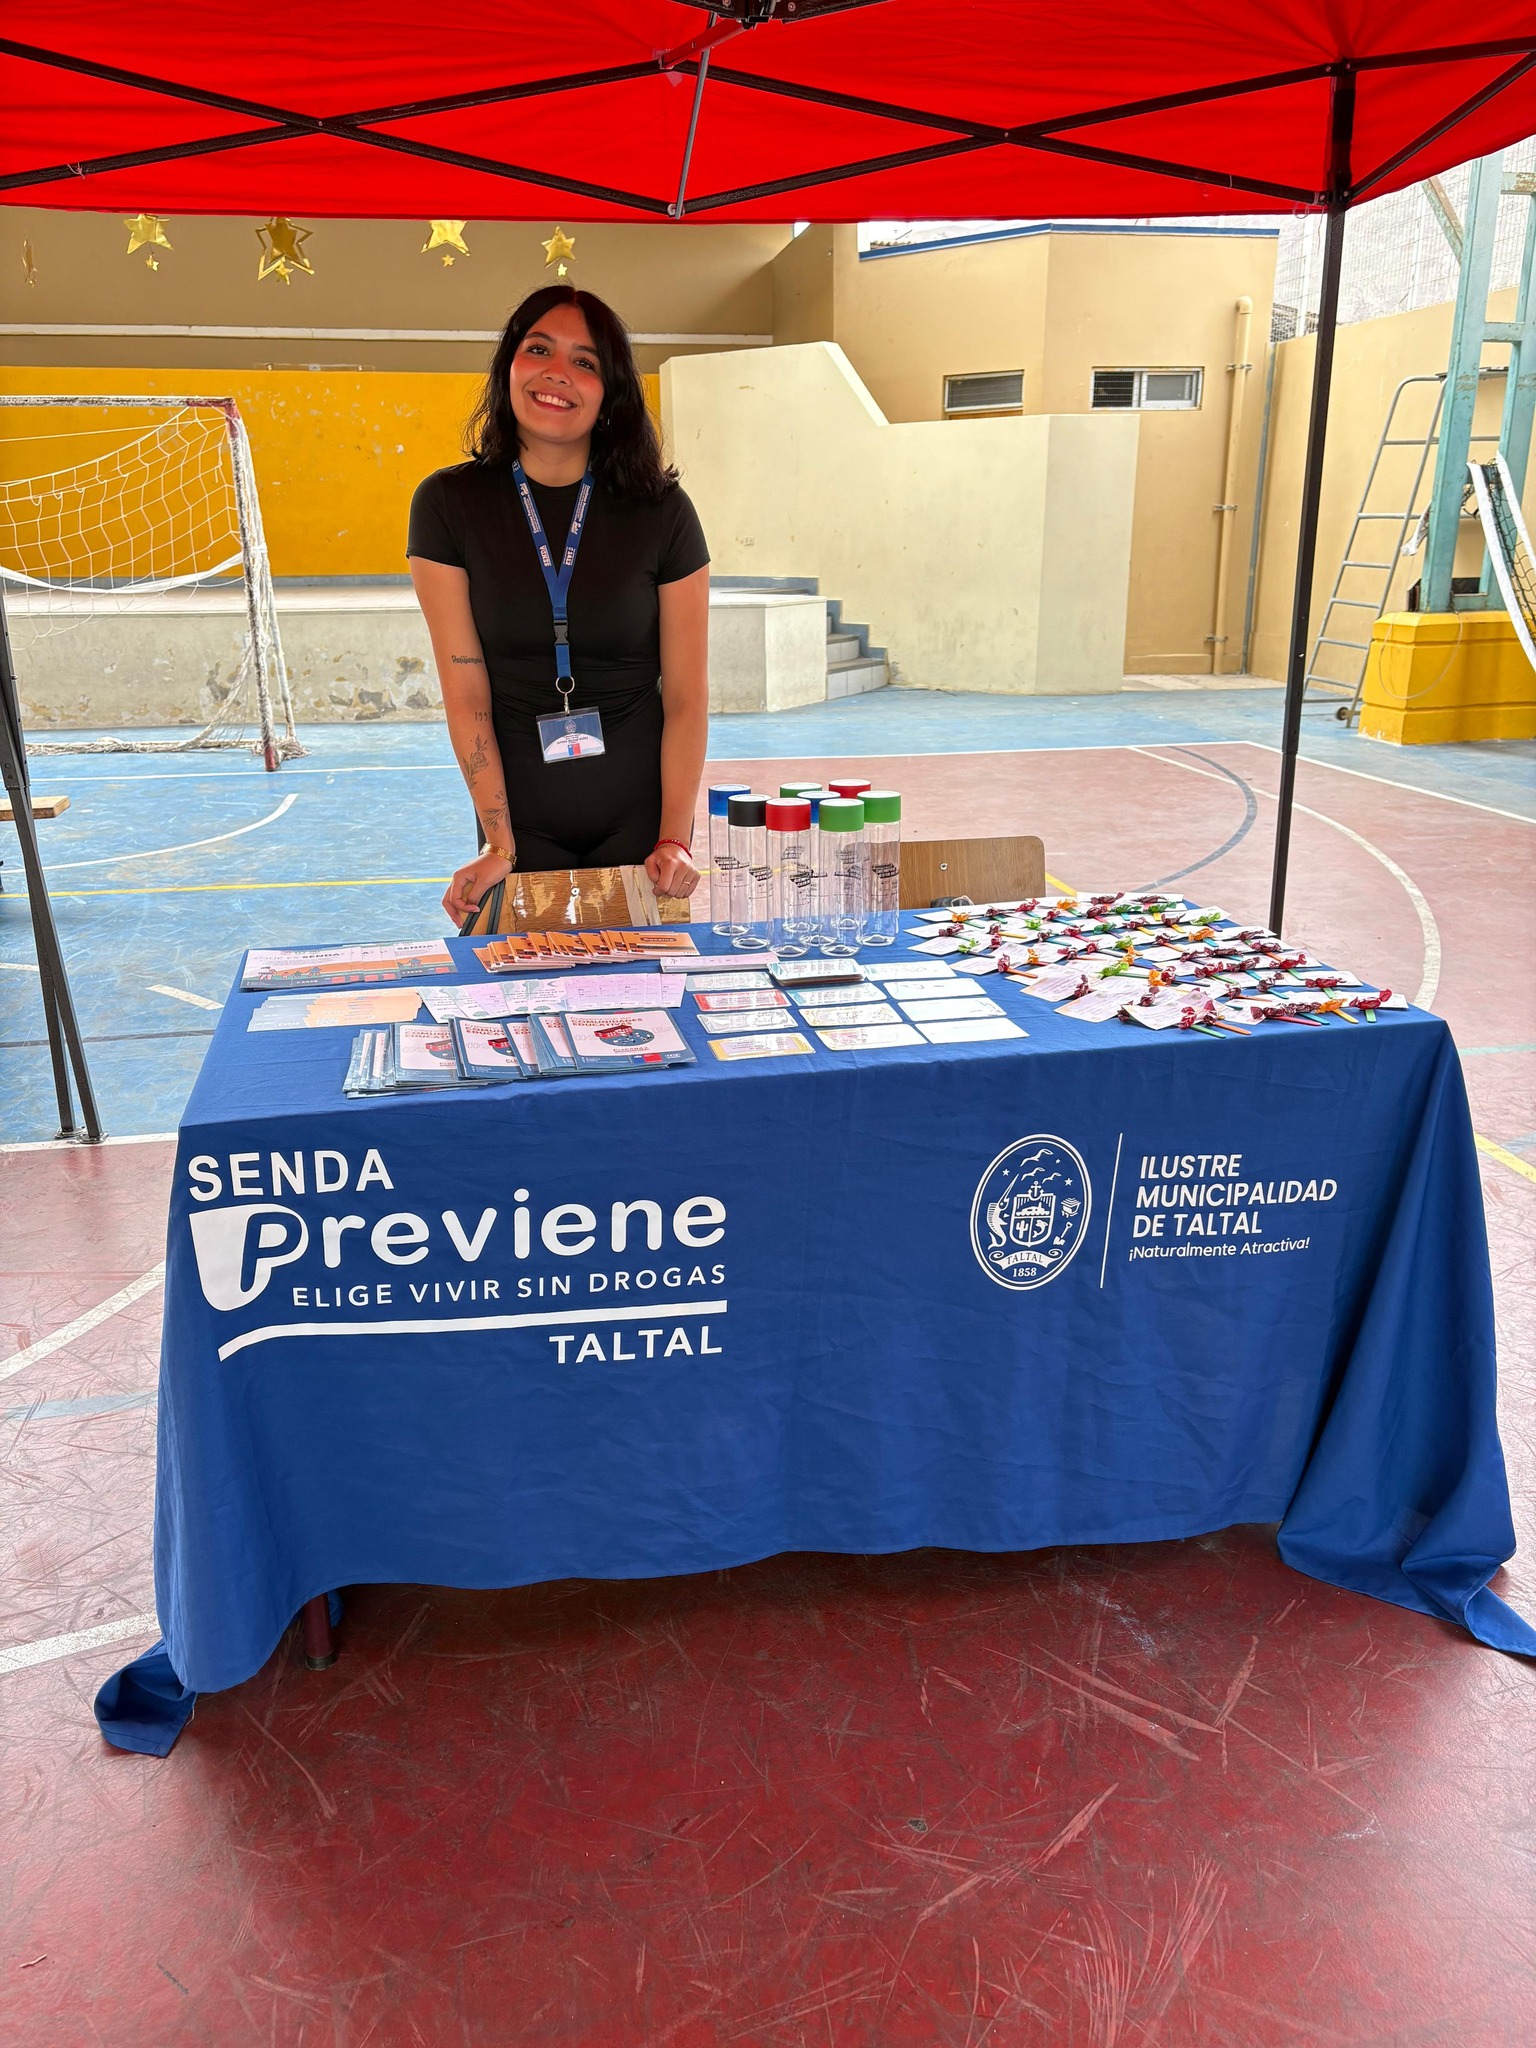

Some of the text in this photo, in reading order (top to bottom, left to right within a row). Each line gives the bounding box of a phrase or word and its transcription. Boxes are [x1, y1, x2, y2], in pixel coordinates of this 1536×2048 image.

[188, 1150, 395, 1202] SENDA
[1140, 1154, 1243, 1179] ILUSTRE
[1136, 1178, 1339, 1209] MUNICIPALIDAD
[1132, 1211, 1263, 1238] DE TALTAL
[238, 1187, 728, 1293] Previene
[1128, 1236, 1310, 1262] ¡Naturalmente Atractiva!
[1006, 1252, 1044, 1265] TALTAL
[1013, 1267, 1038, 1277] 1858
[292, 1264, 726, 1307] ELIGE VIVIR SIN DROGAS
[548, 1326, 723, 1364] TALTAL
